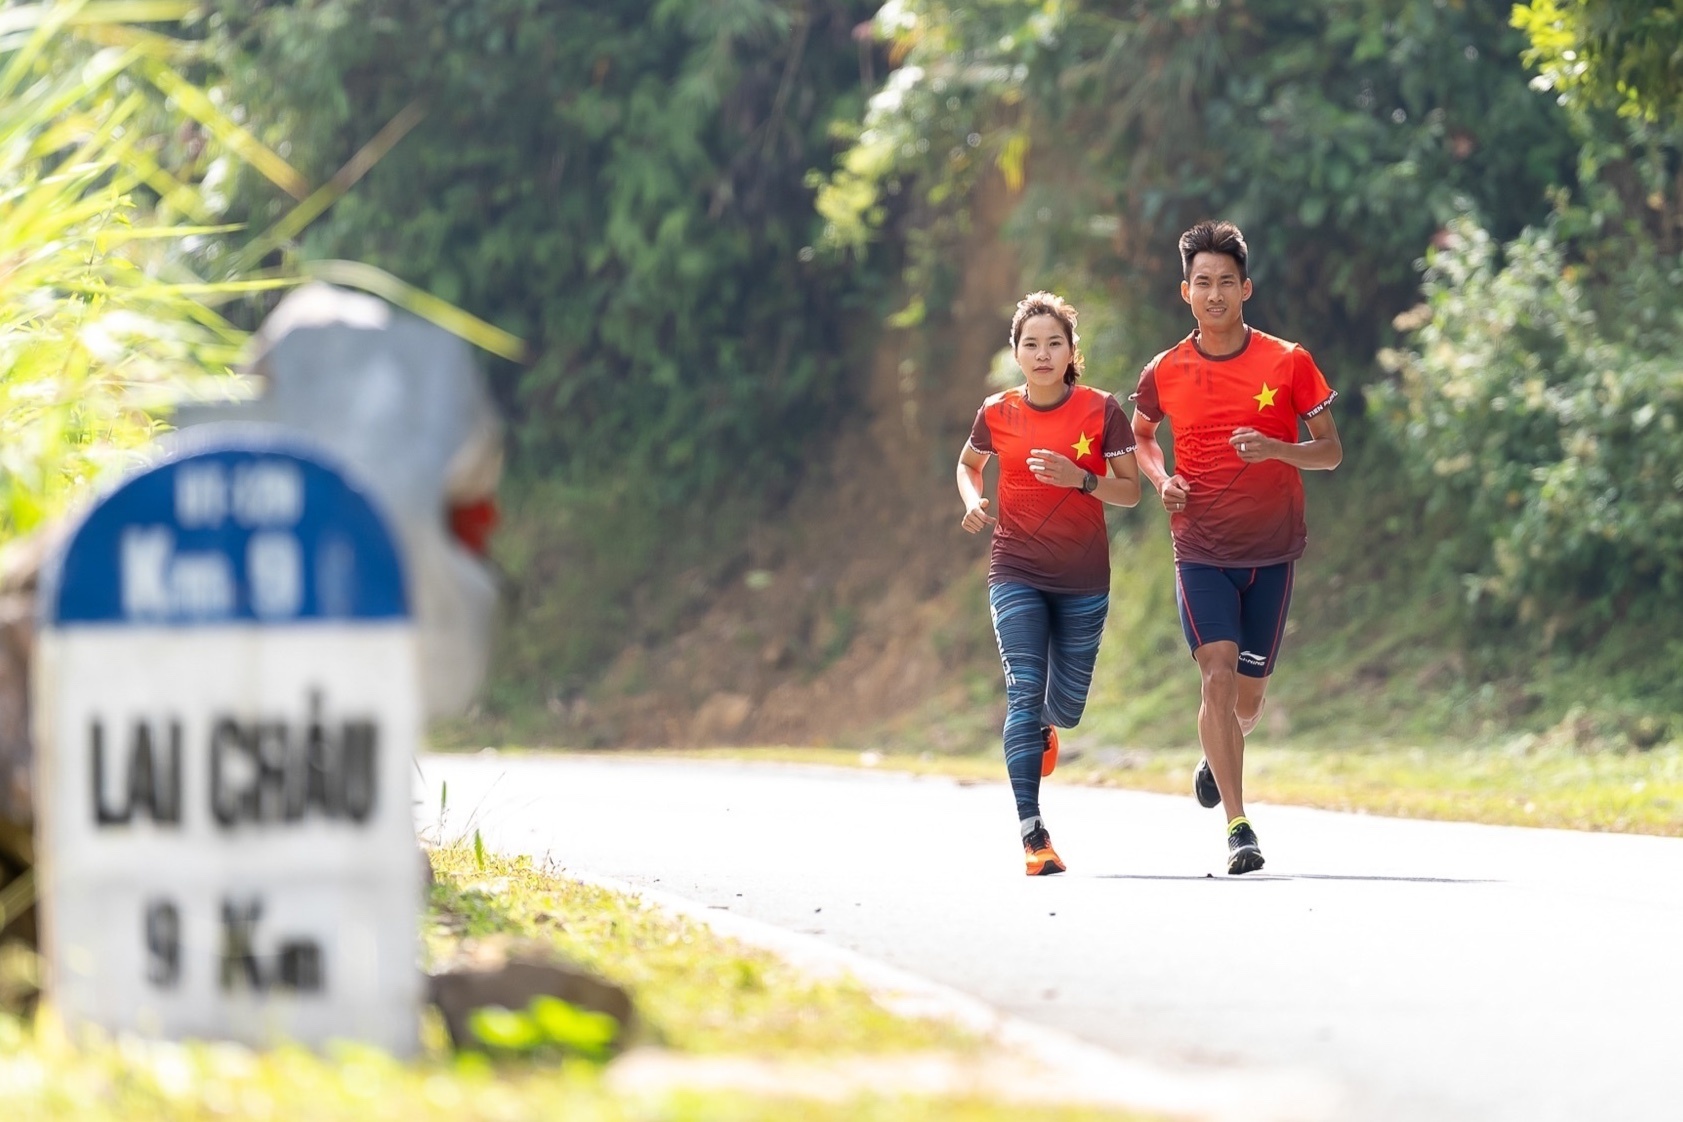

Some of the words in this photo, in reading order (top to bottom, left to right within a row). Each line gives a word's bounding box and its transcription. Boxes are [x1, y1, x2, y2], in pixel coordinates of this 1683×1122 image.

[1103, 449, 1125, 458] IONAL
[1307, 404, 1323, 417] TIEN
[122, 524, 235, 621] Km
[91, 714, 182, 827] LAI
[144, 896, 182, 987] 9
[219, 897, 325, 989] Km
